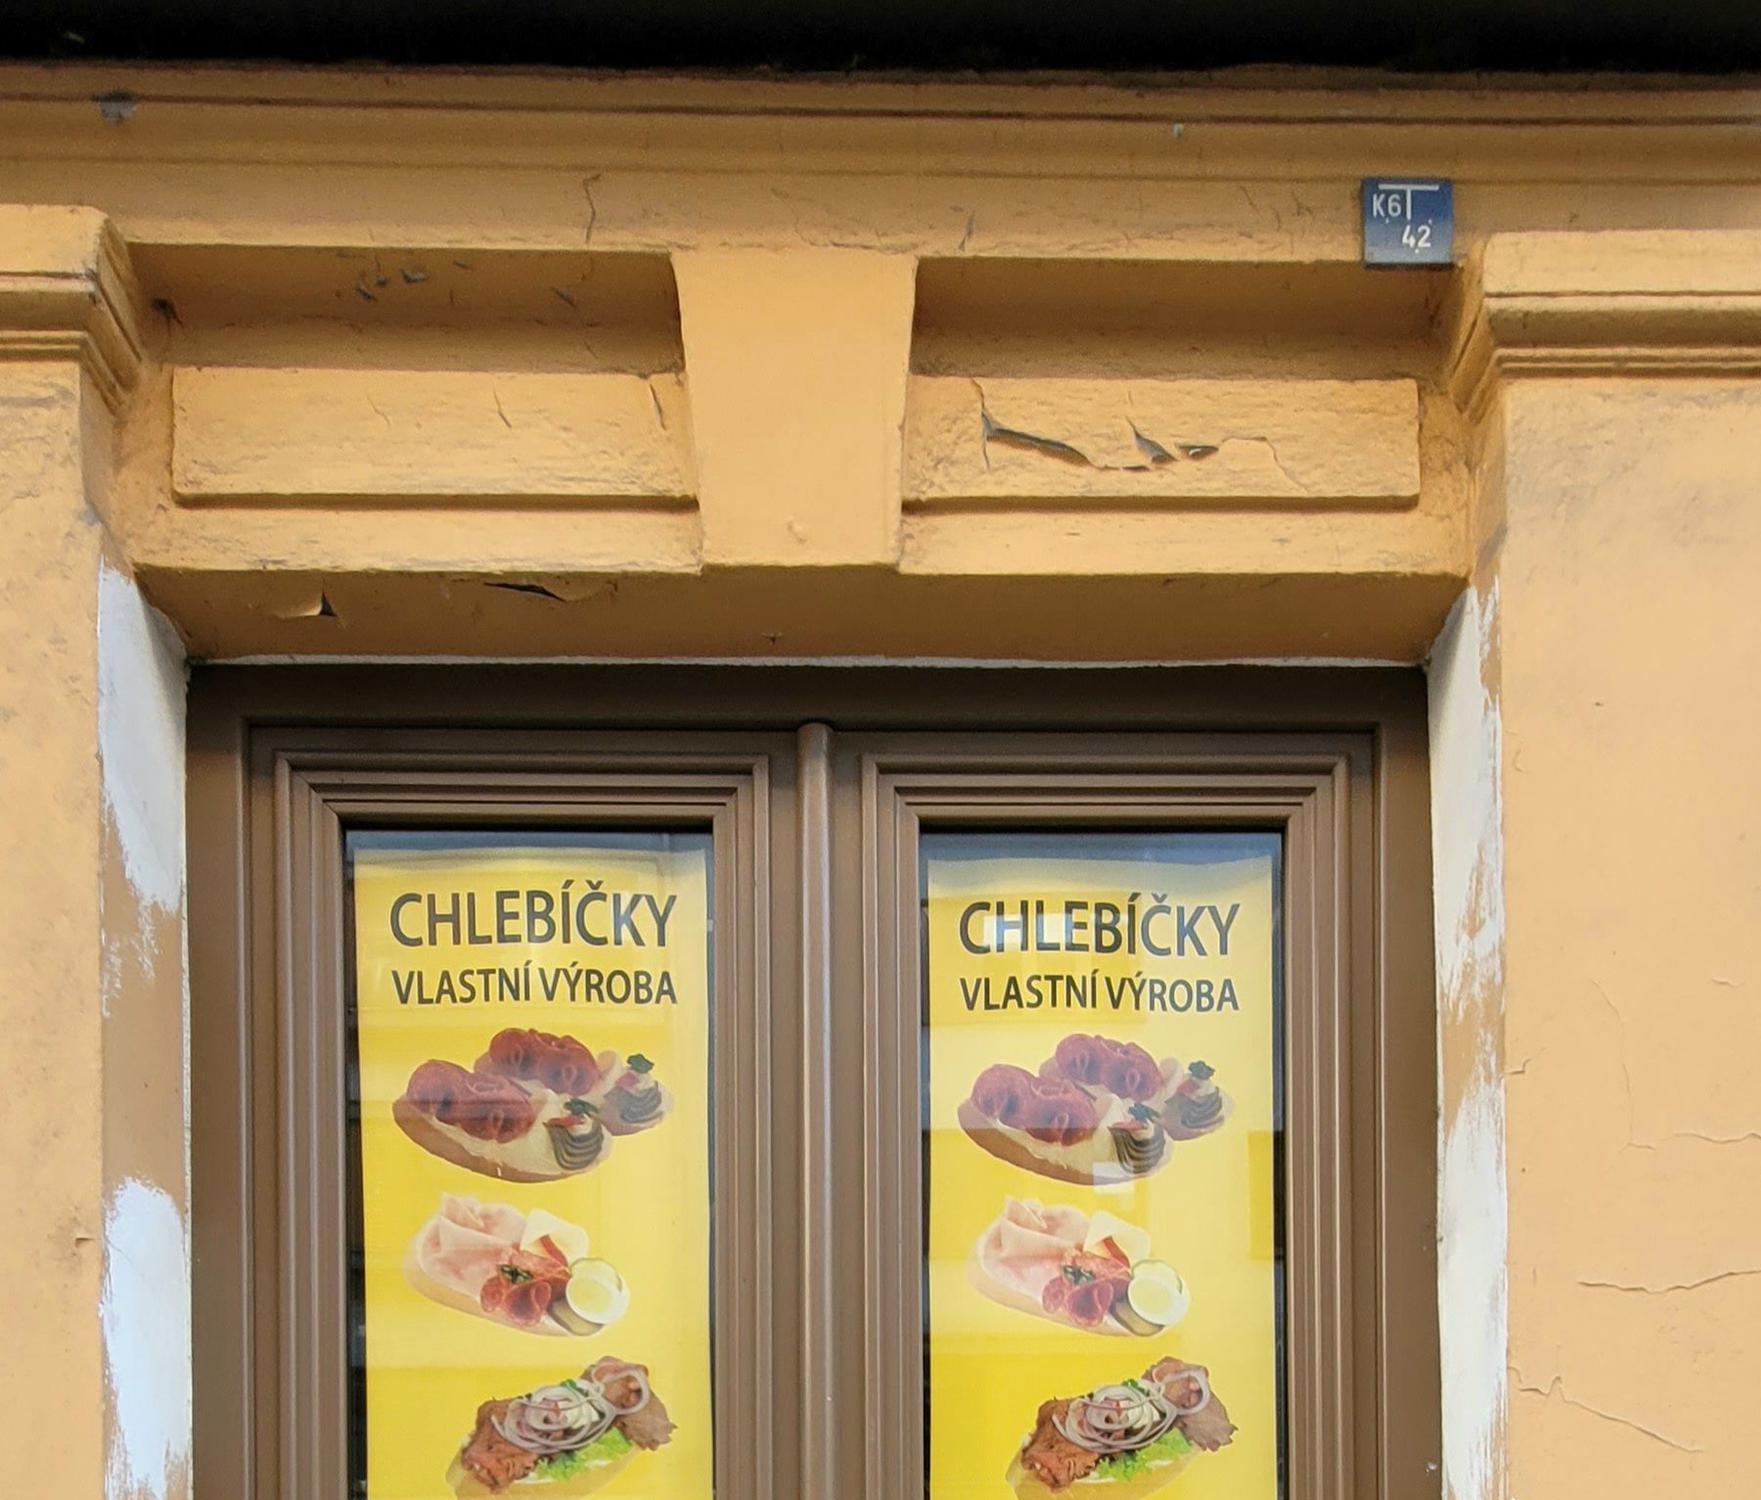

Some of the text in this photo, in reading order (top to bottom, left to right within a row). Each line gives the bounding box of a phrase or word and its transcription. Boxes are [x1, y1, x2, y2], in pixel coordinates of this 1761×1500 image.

[390, 880, 678, 948] CHLEBÍČKY
[959, 892, 1240, 957] CHLEBÍČKY
[392, 960, 678, 1005] VLASTNÍ VÝROBA
[960, 969, 1240, 1012] VLASTNÍ VÝROBA
